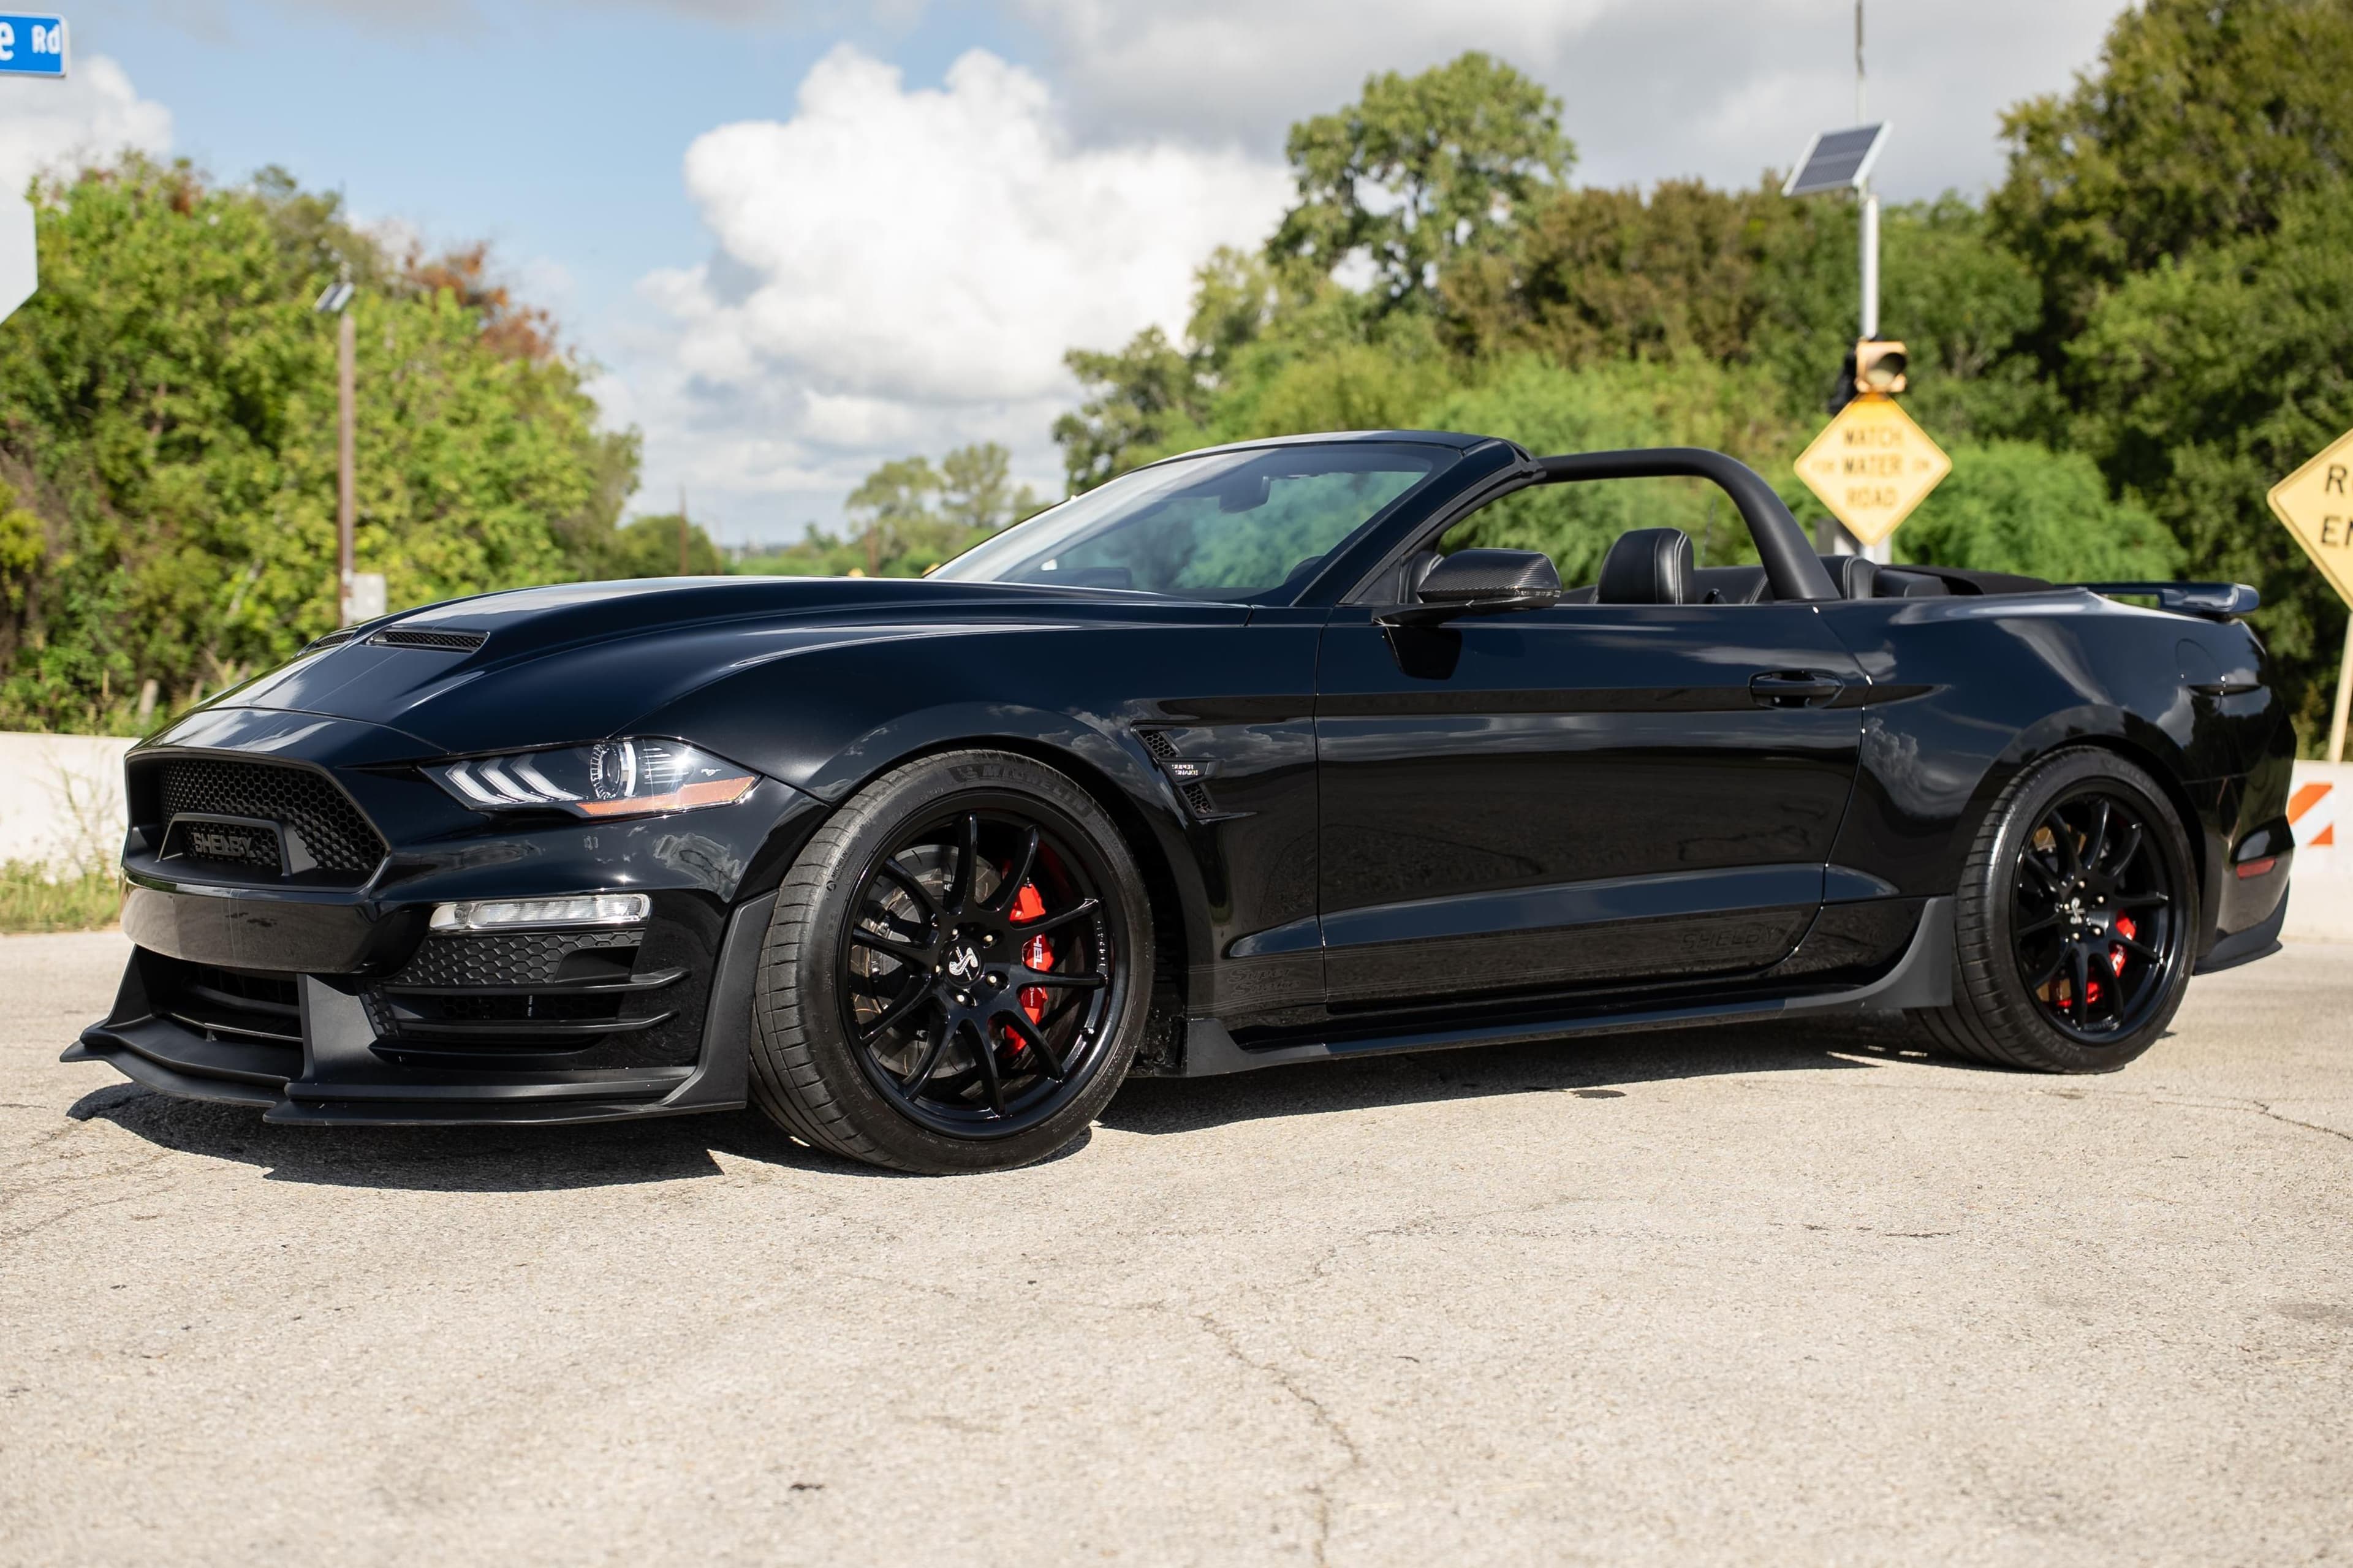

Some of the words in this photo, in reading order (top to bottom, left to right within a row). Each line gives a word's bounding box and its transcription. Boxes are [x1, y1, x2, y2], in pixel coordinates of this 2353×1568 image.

[31, 24, 60, 54] Rd
[1844, 455, 1903, 477] WATER
[2325, 464, 2353, 494] R
[1846, 486, 1897, 509] ROAD
[982, 765, 1089, 812] MICHELIN
[192, 832, 252, 857] SHELBY
[831, 850, 848, 879] MICHELIN
